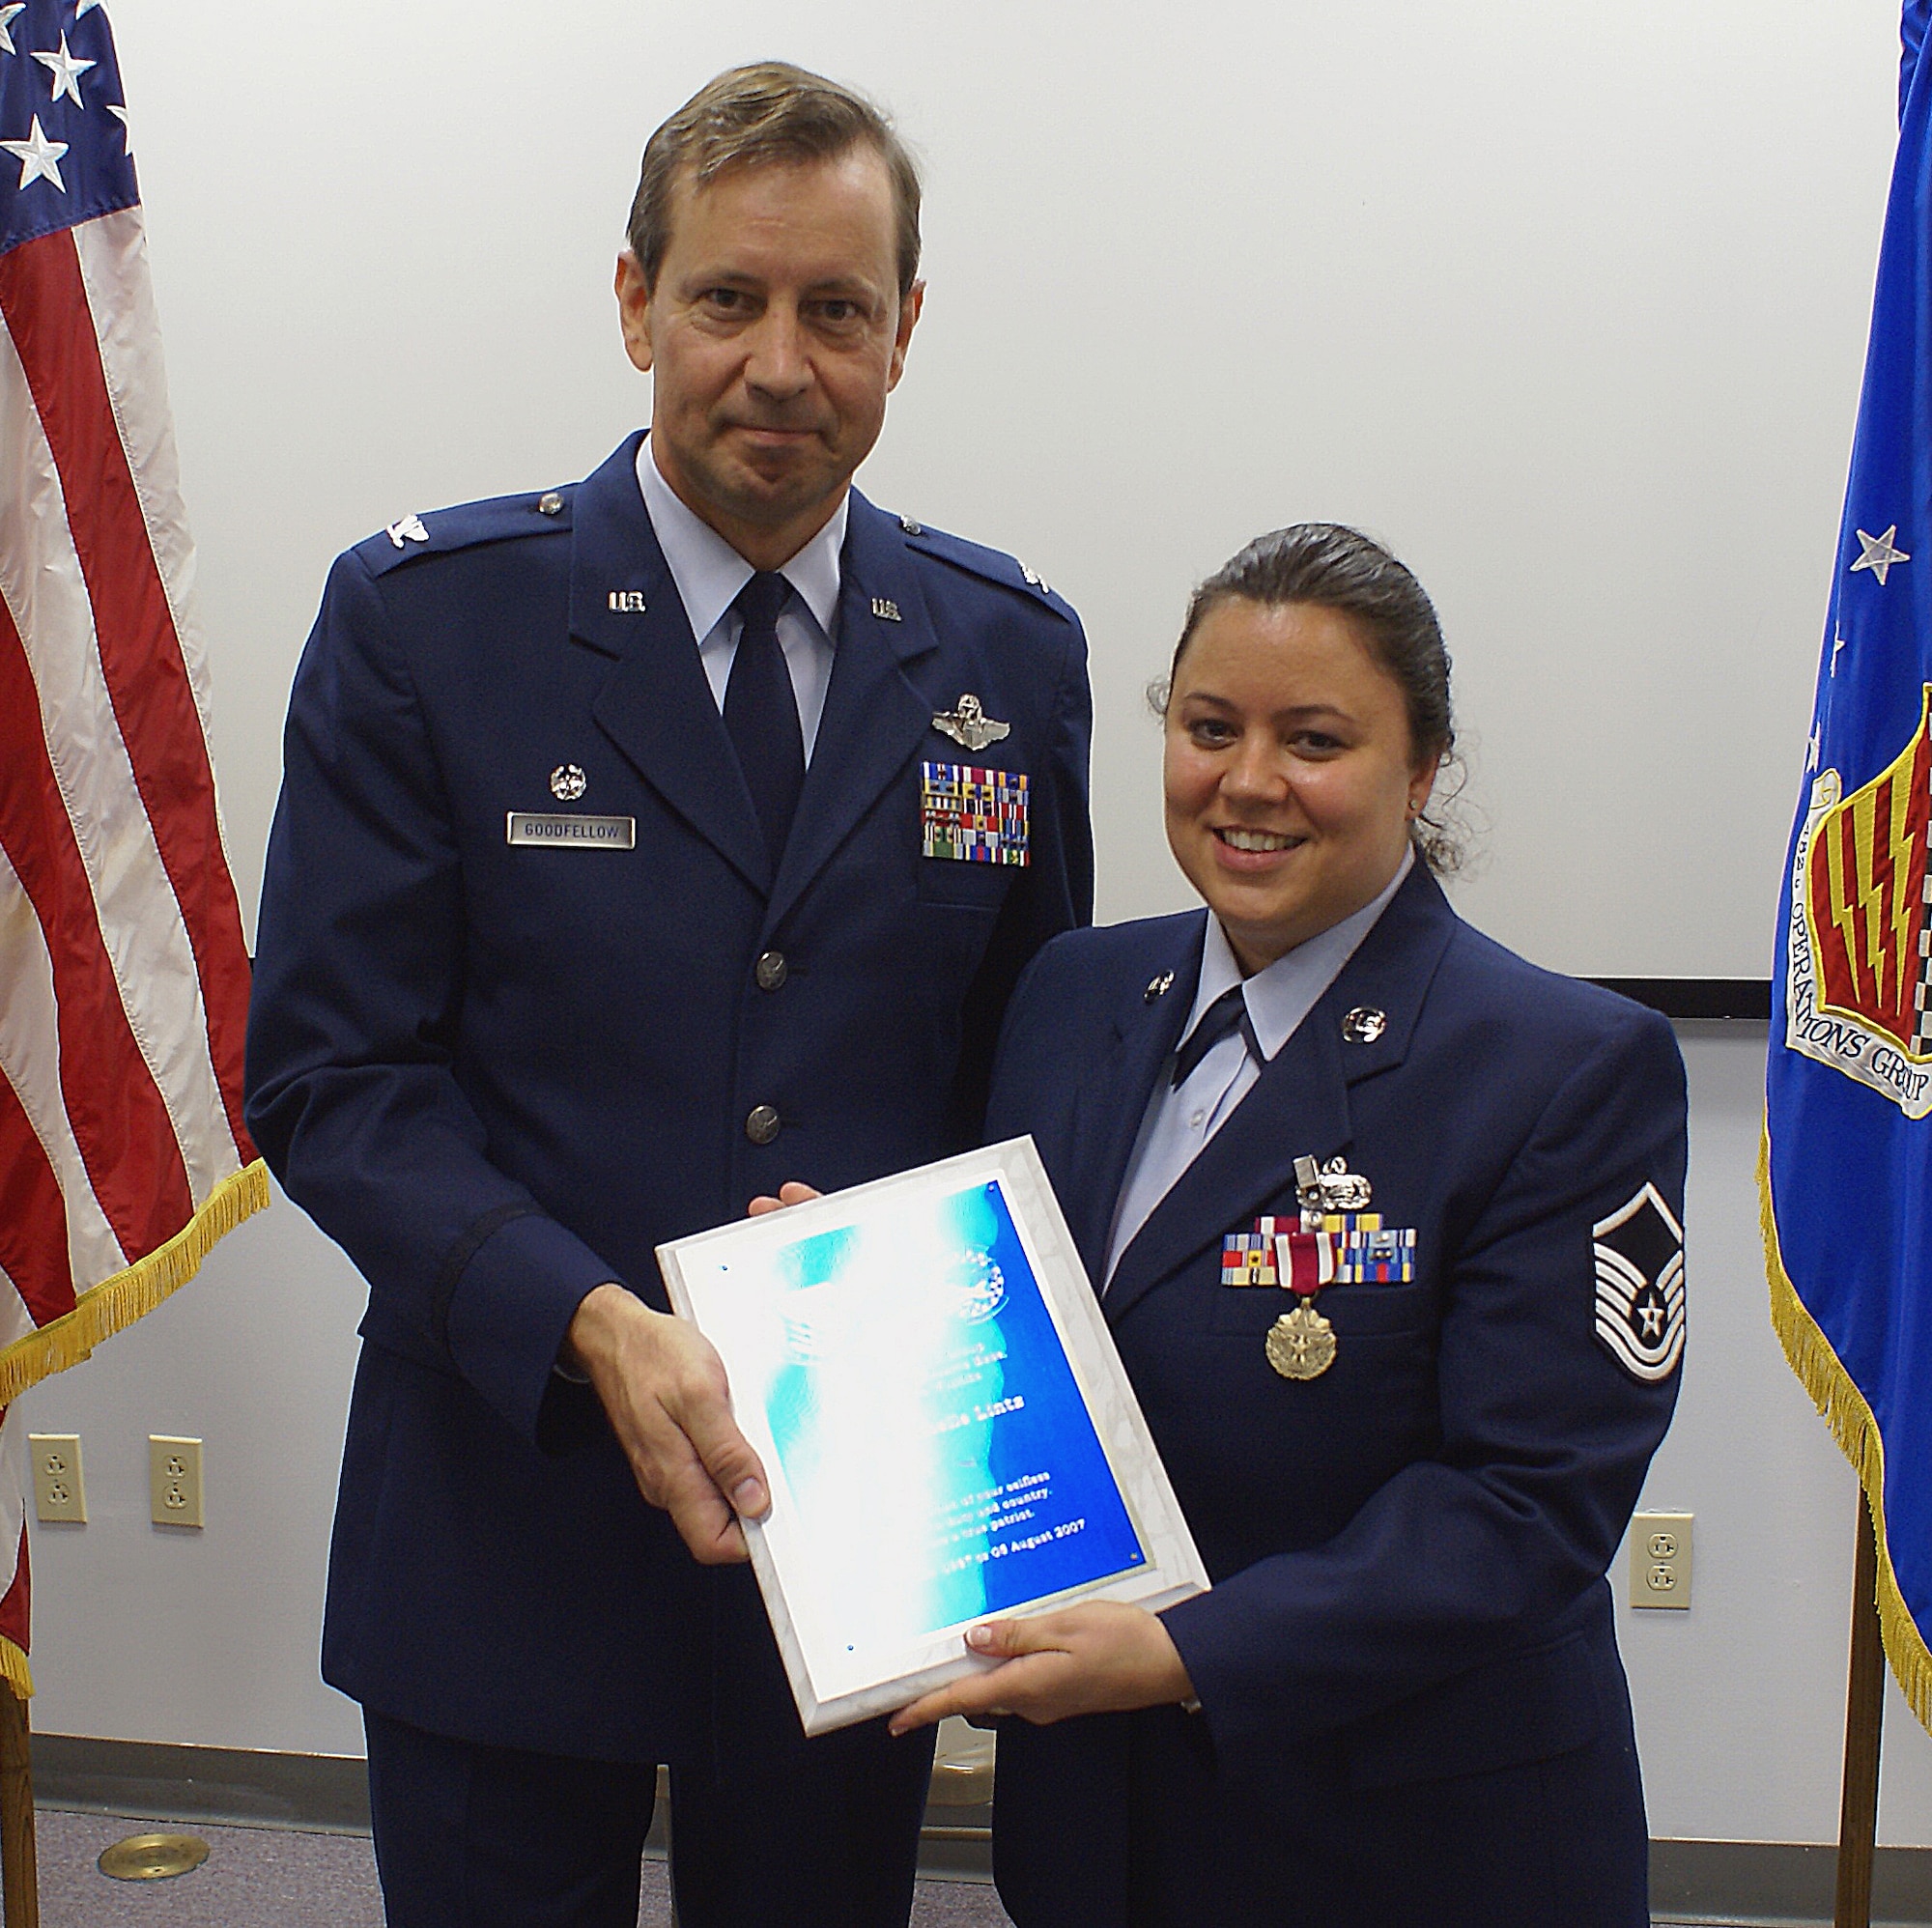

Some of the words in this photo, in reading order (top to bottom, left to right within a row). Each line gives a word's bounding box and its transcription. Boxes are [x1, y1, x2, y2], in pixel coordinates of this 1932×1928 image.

[525, 823, 619, 839] GOODFELLOW
[1792, 902, 1871, 1058] OPERATIONS
[974, 1396, 1025, 1421] Lintz
[1006, 1471, 1050, 1492] selfless
[1002, 1487, 1053, 1510] country.
[989, 1509, 1035, 1532] patriot.
[1010, 1530, 1054, 1553] August
[1053, 1517, 1085, 1539] 2007
